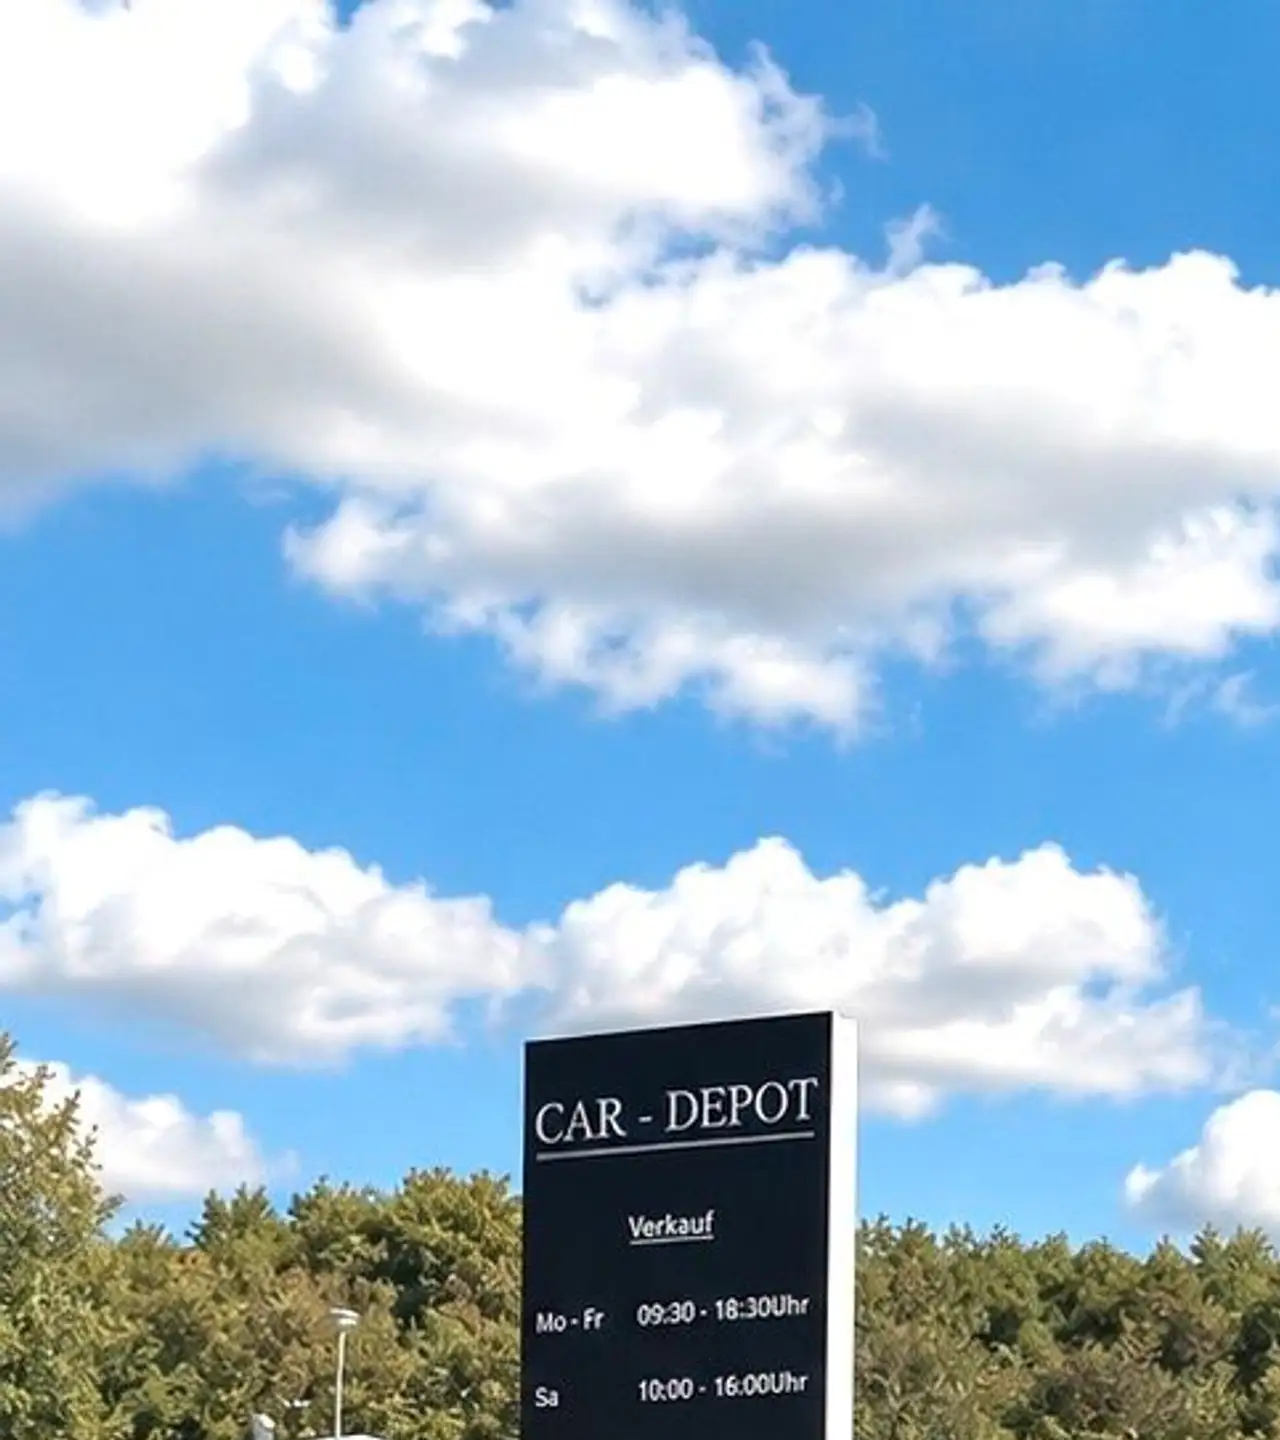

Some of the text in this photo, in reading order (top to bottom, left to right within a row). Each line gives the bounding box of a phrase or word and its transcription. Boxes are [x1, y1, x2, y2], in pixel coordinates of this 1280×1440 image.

[535, 1077, 819, 1144] CAR - DEPOT
[628, 1209, 715, 1238] Verkauf
[535, 1311, 567, 1334] Mo
[582, 1307, 605, 1331] Fr
[636, 1300, 696, 1328] 09:30
[534, 1386, 559, 1408] Sa
[638, 1377, 694, 1402] 10:00
